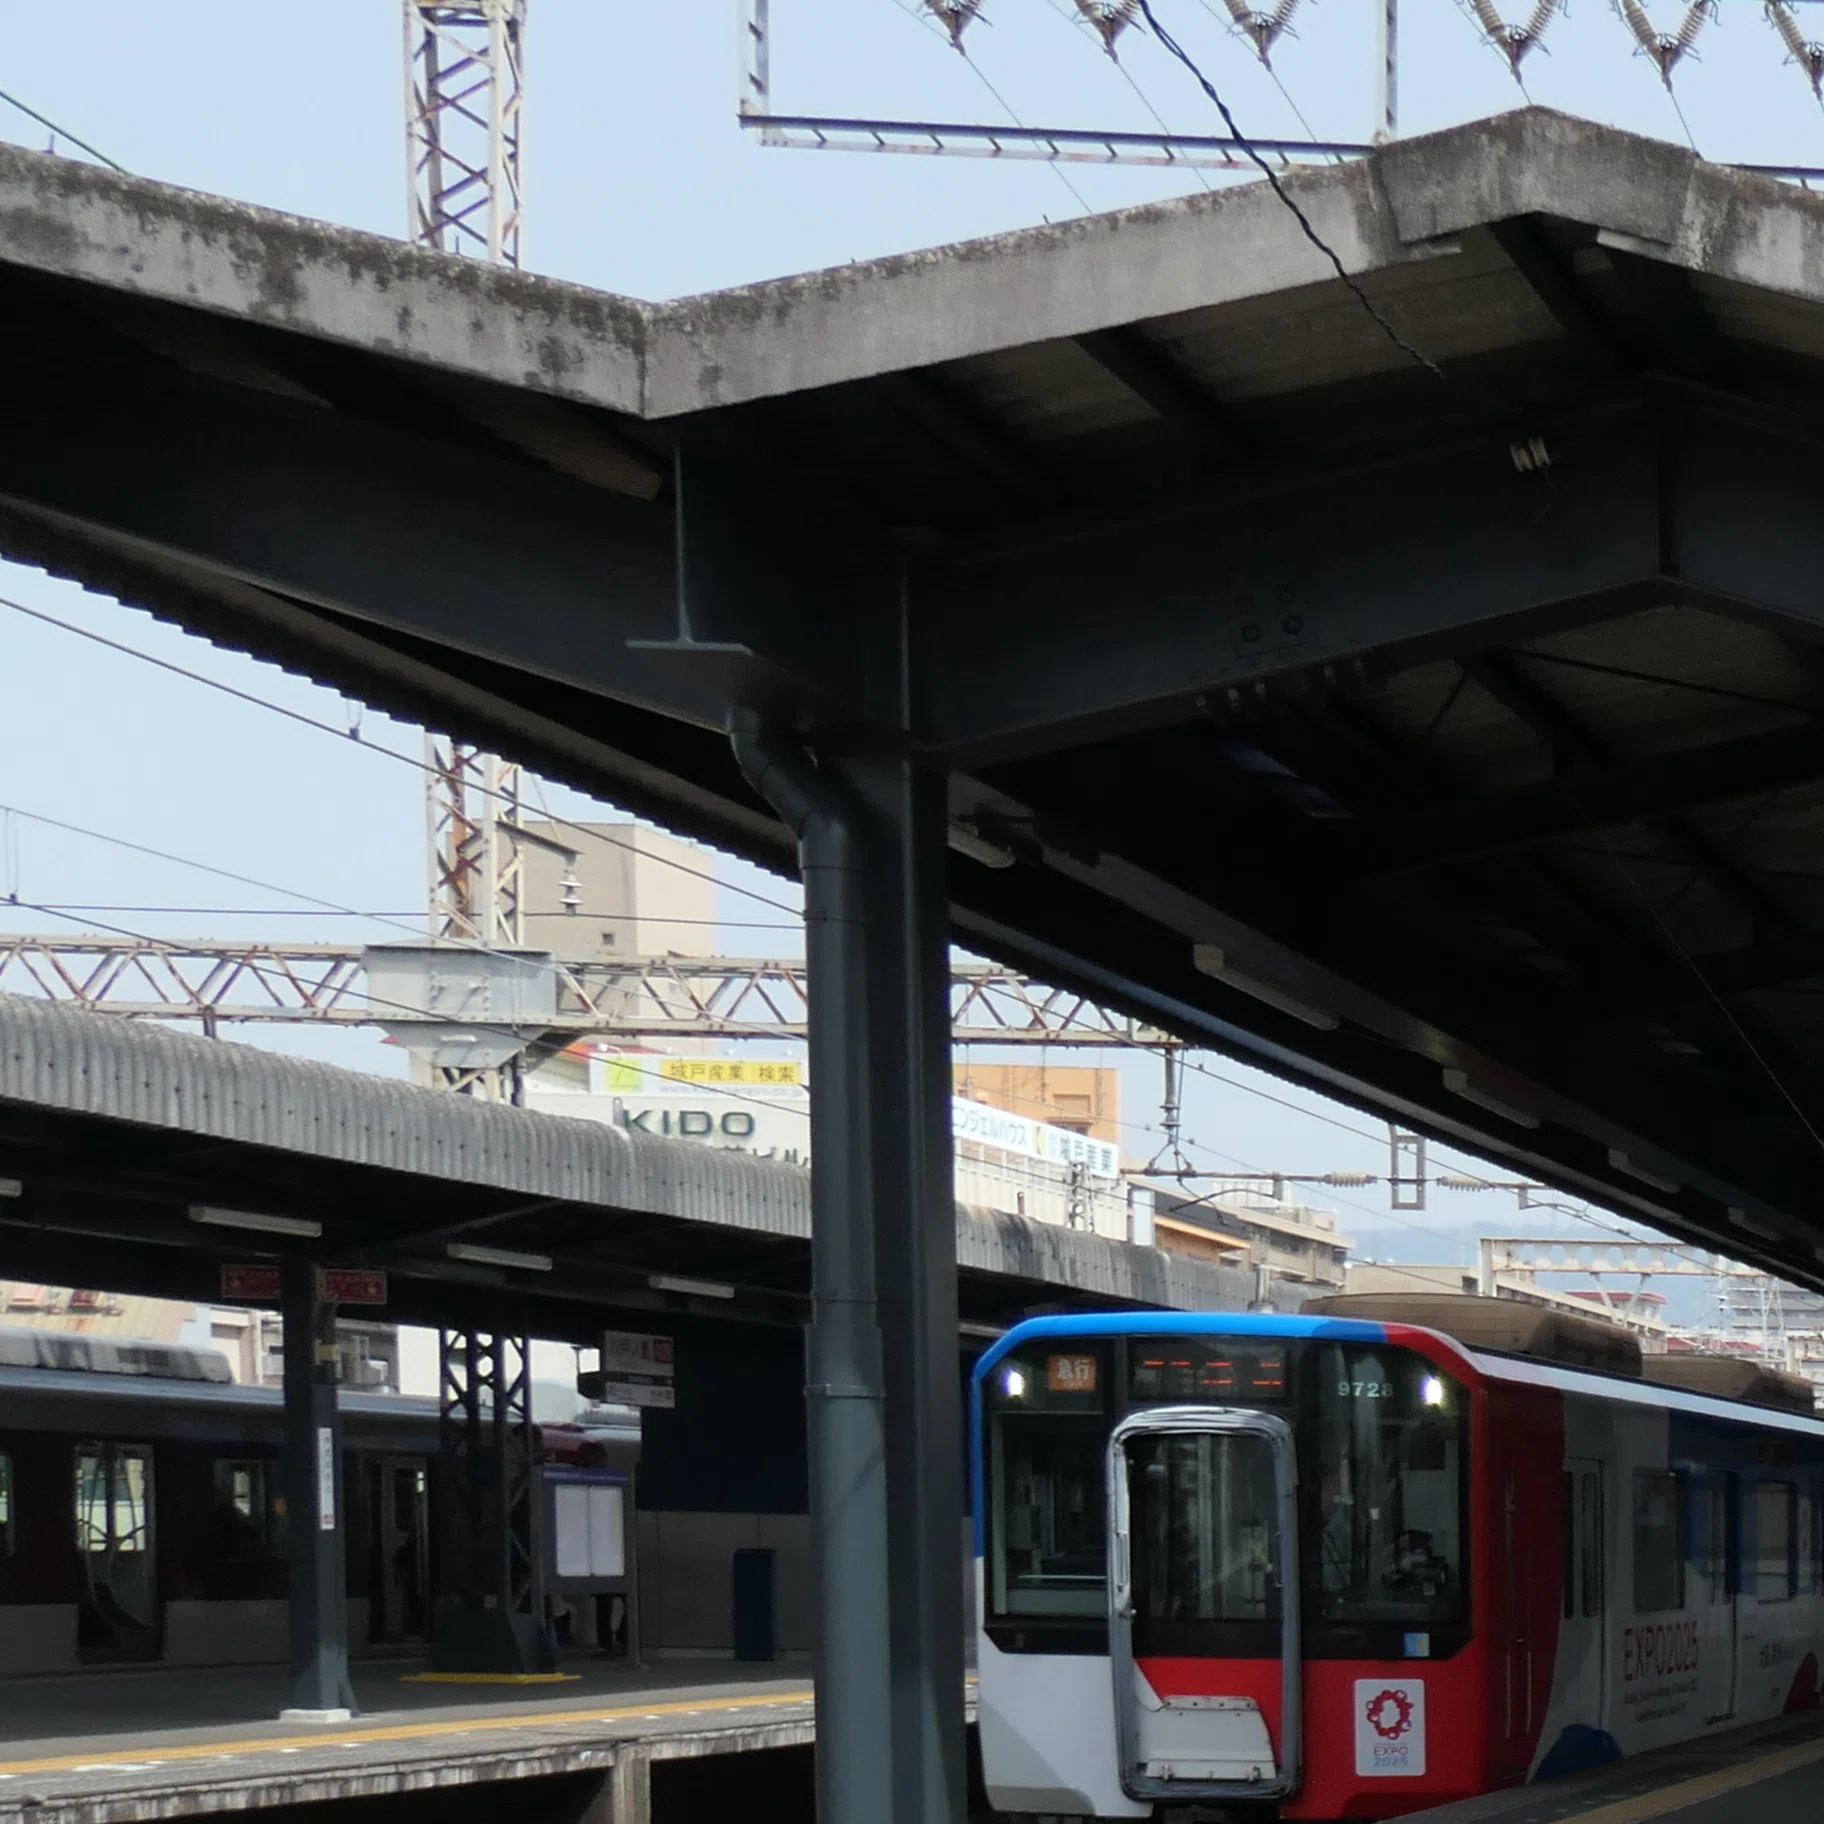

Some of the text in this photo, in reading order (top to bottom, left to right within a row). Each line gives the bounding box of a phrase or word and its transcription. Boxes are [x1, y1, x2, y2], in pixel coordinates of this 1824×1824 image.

[670, 1063, 795, 1083] 城戸産業 検索
[622, 1109, 756, 1137] KIDO
[953, 1105, 1028, 1147] ンジェルハウス
[1056, 1358, 1090, 1381] 急行
[1338, 1381, 1394, 1398] 9728
[1624, 1620, 1699, 1682] EXPO2025
[1374, 1746, 1409, 1757] EXPO
[1374, 1757, 1409, 1768] 2025
